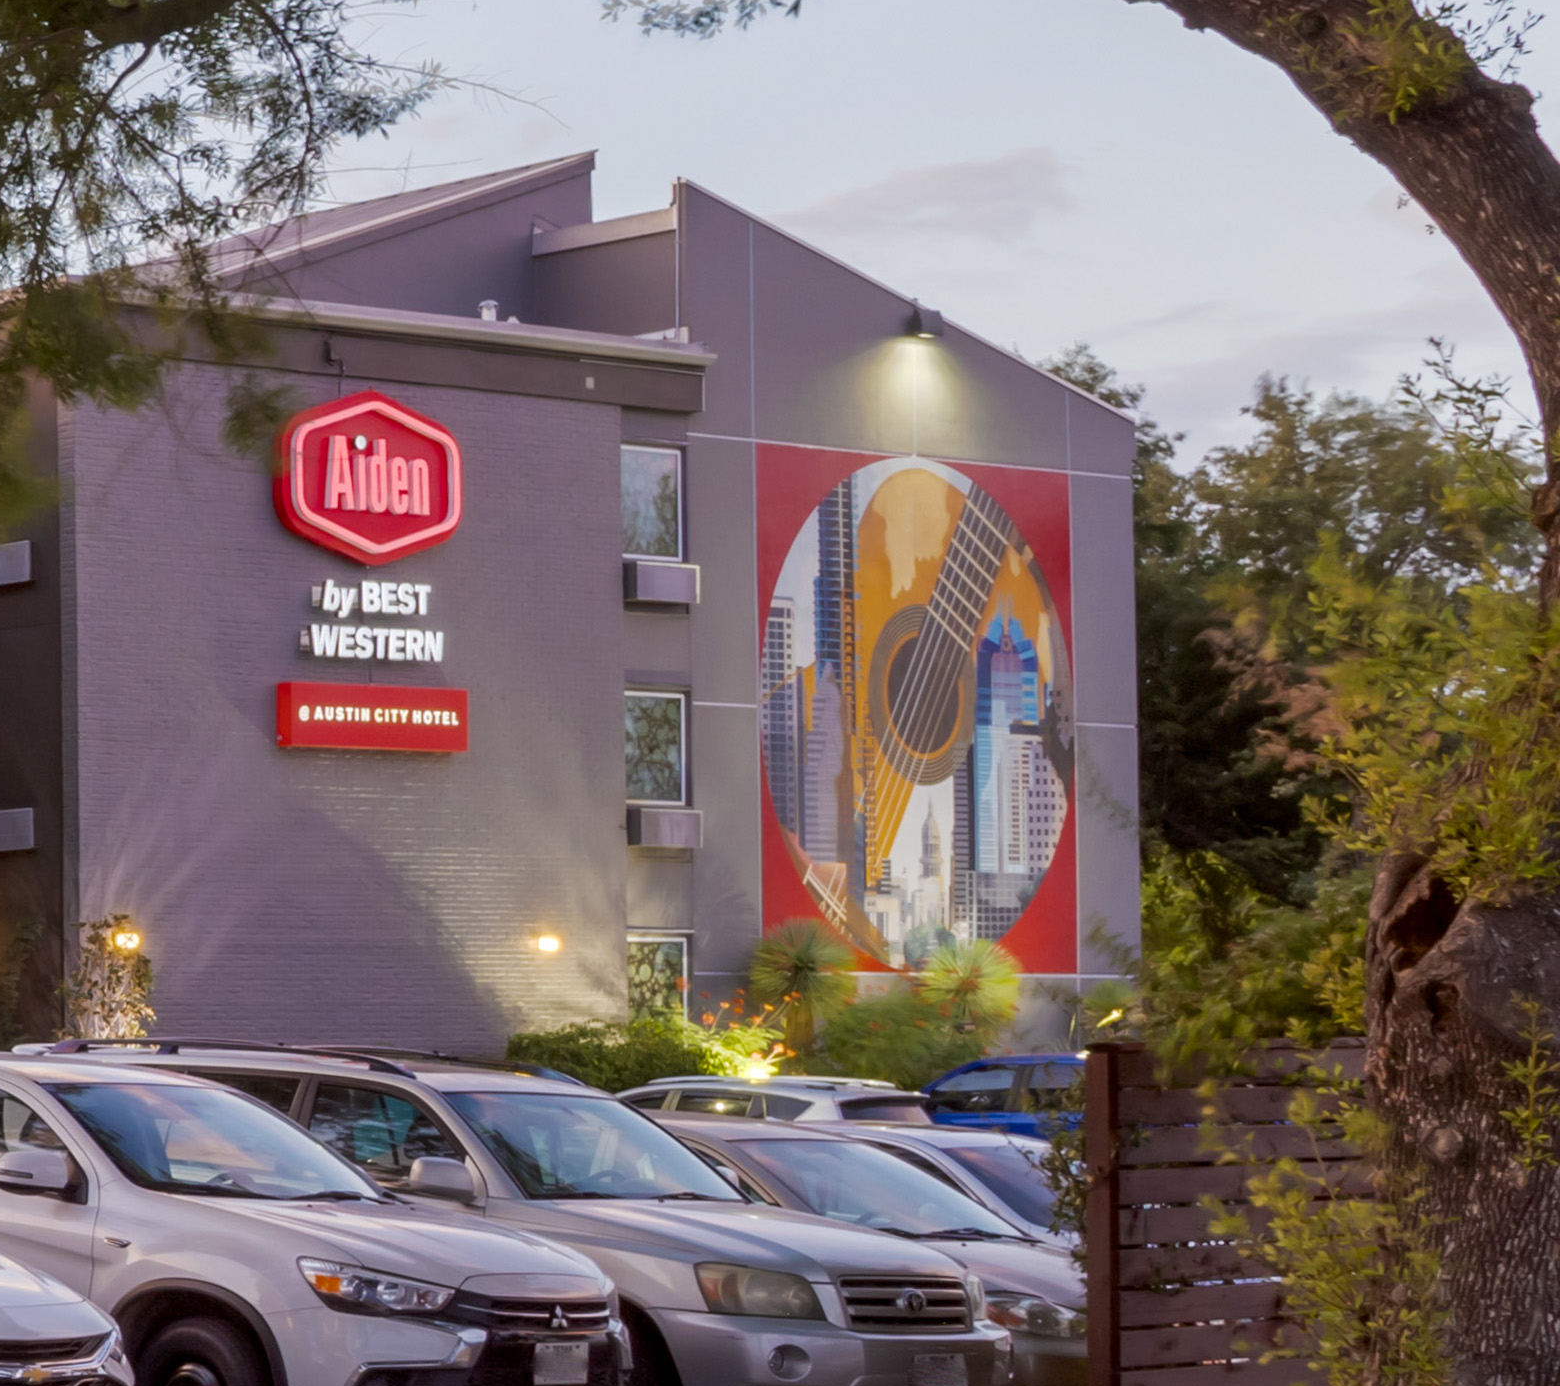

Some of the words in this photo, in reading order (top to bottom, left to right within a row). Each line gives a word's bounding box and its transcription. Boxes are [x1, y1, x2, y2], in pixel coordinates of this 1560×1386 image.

[324, 434, 430, 516] Aiden
[322, 579, 357, 618] by
[361, 580, 431, 616] BEST
[310, 623, 444, 662] WESTERN
[298, 705, 310, 722] @
[313, 706, 370, 722] AUSTIN
[374, 708, 409, 723] CITY
[412, 710, 459, 726] HOTEL
